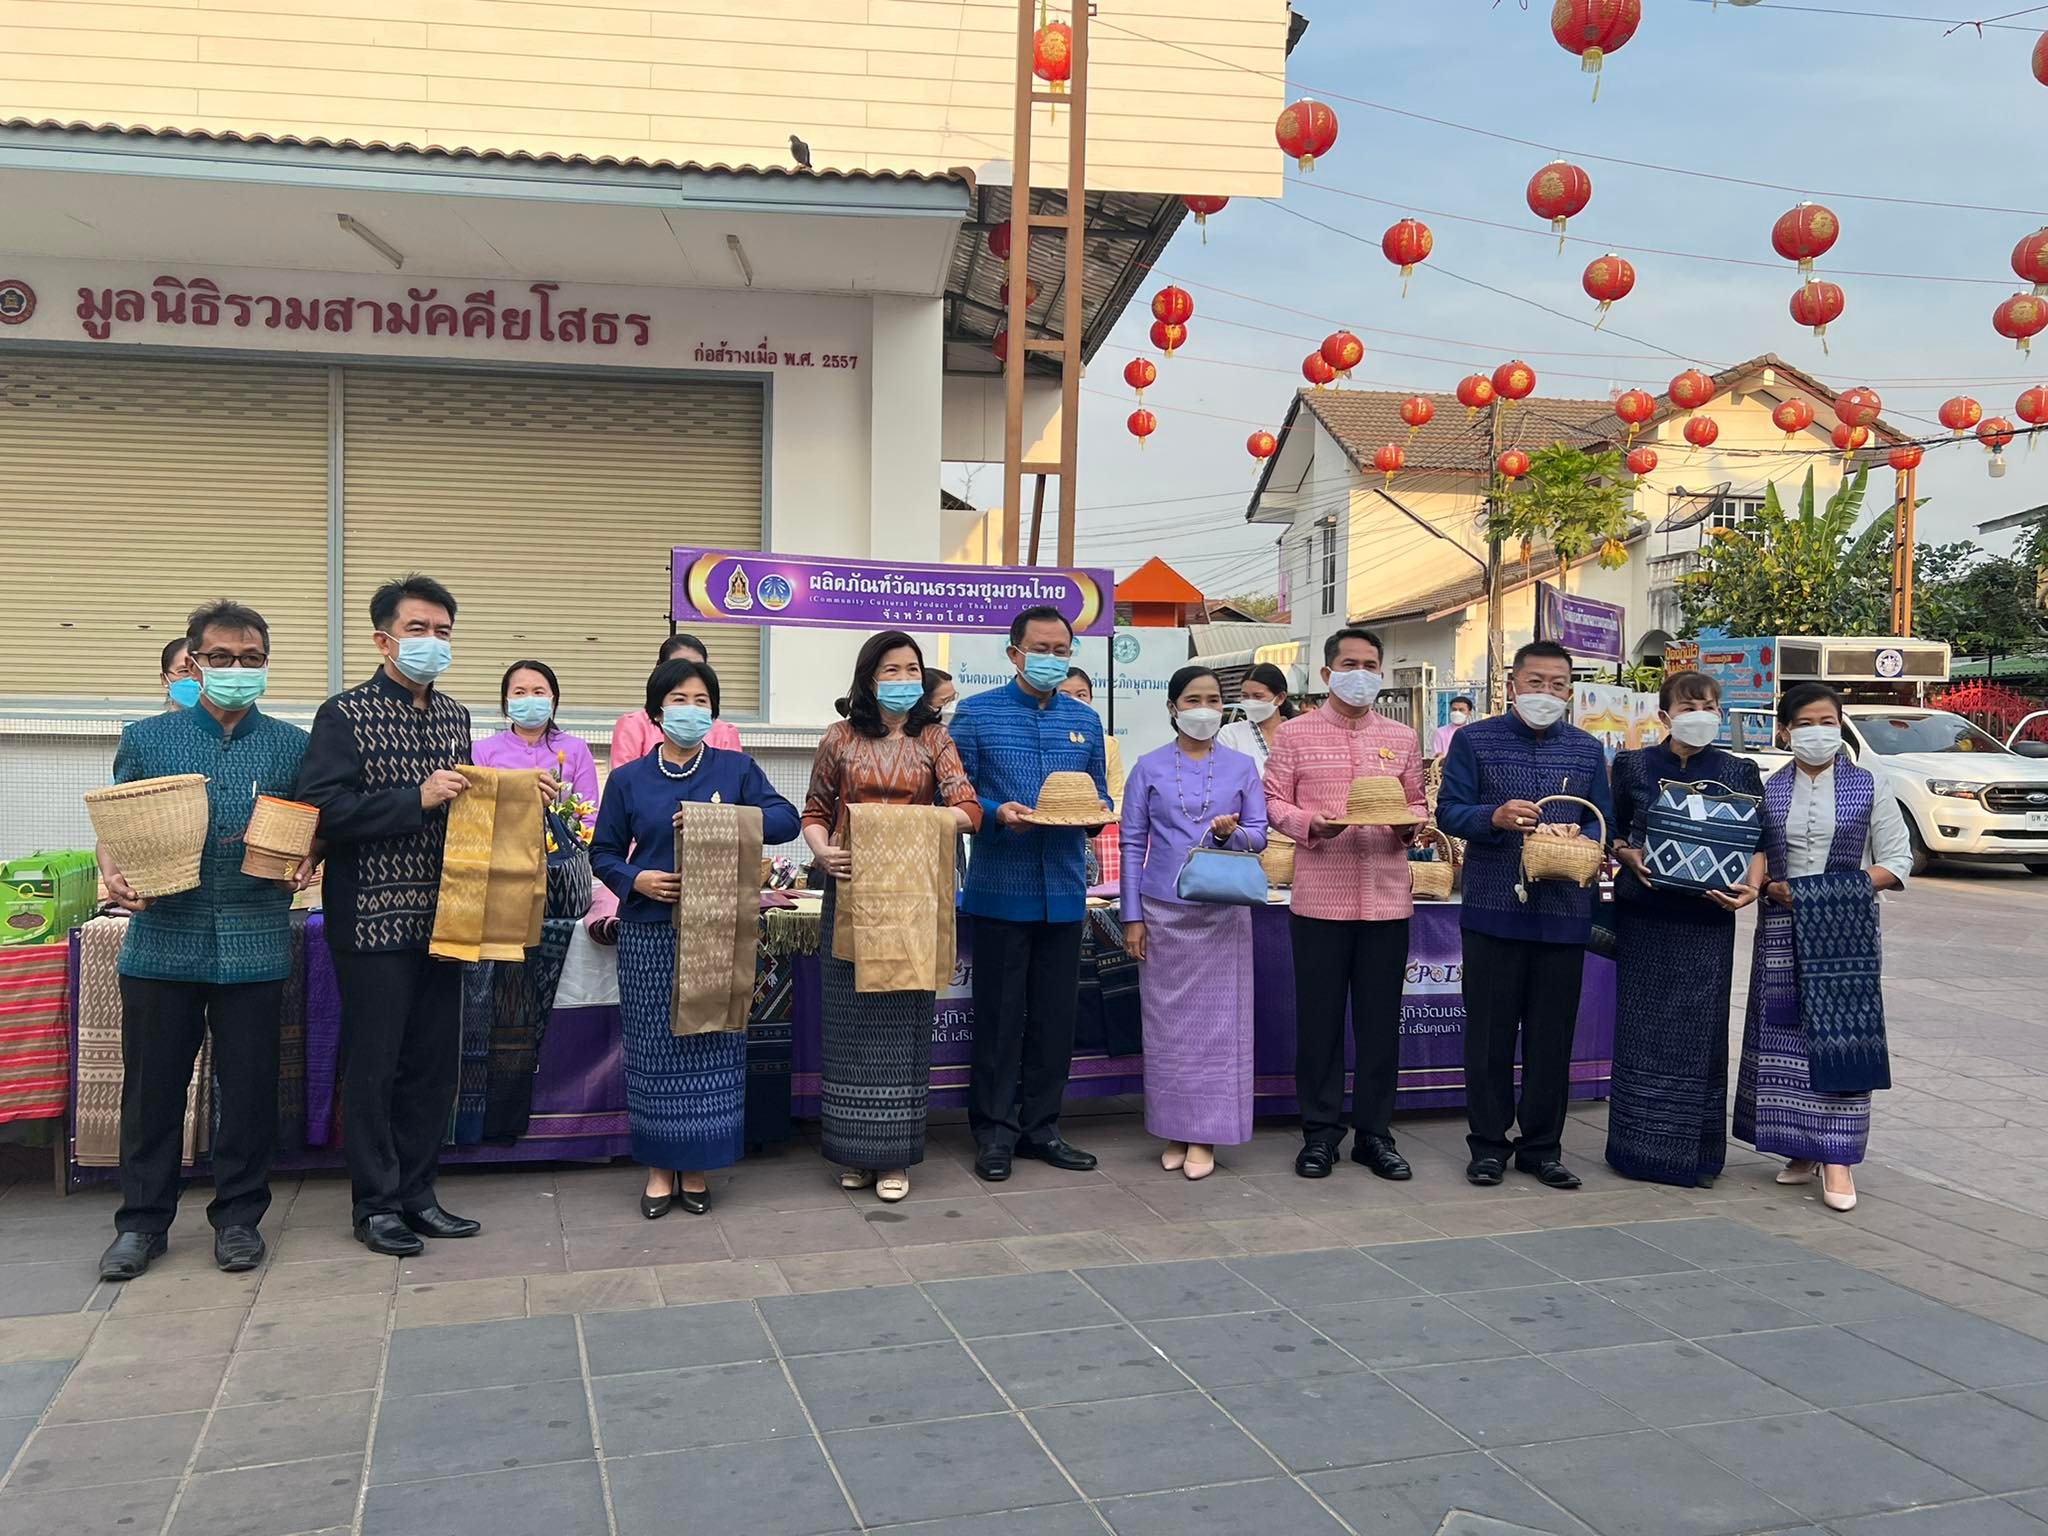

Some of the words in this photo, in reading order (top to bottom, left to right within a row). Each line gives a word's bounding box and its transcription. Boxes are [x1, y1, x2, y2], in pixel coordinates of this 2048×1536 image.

[76, 275, 651, 347] มูลนิธิรวมสามัคคียโสธร
[784, 352, 815, 367] พ.ศ.
[822, 354, 858, 369] 2557
[809, 571, 1066, 603] ผลิตภัณฑ์วัฒนธรรมชุมชนไทย
[869, 598, 908, 607] Cultural
[913, 601, 948, 609] Product
[969, 602, 1009, 610] Thailand
[882, 608, 985, 622] จังหวัดยโสธร
